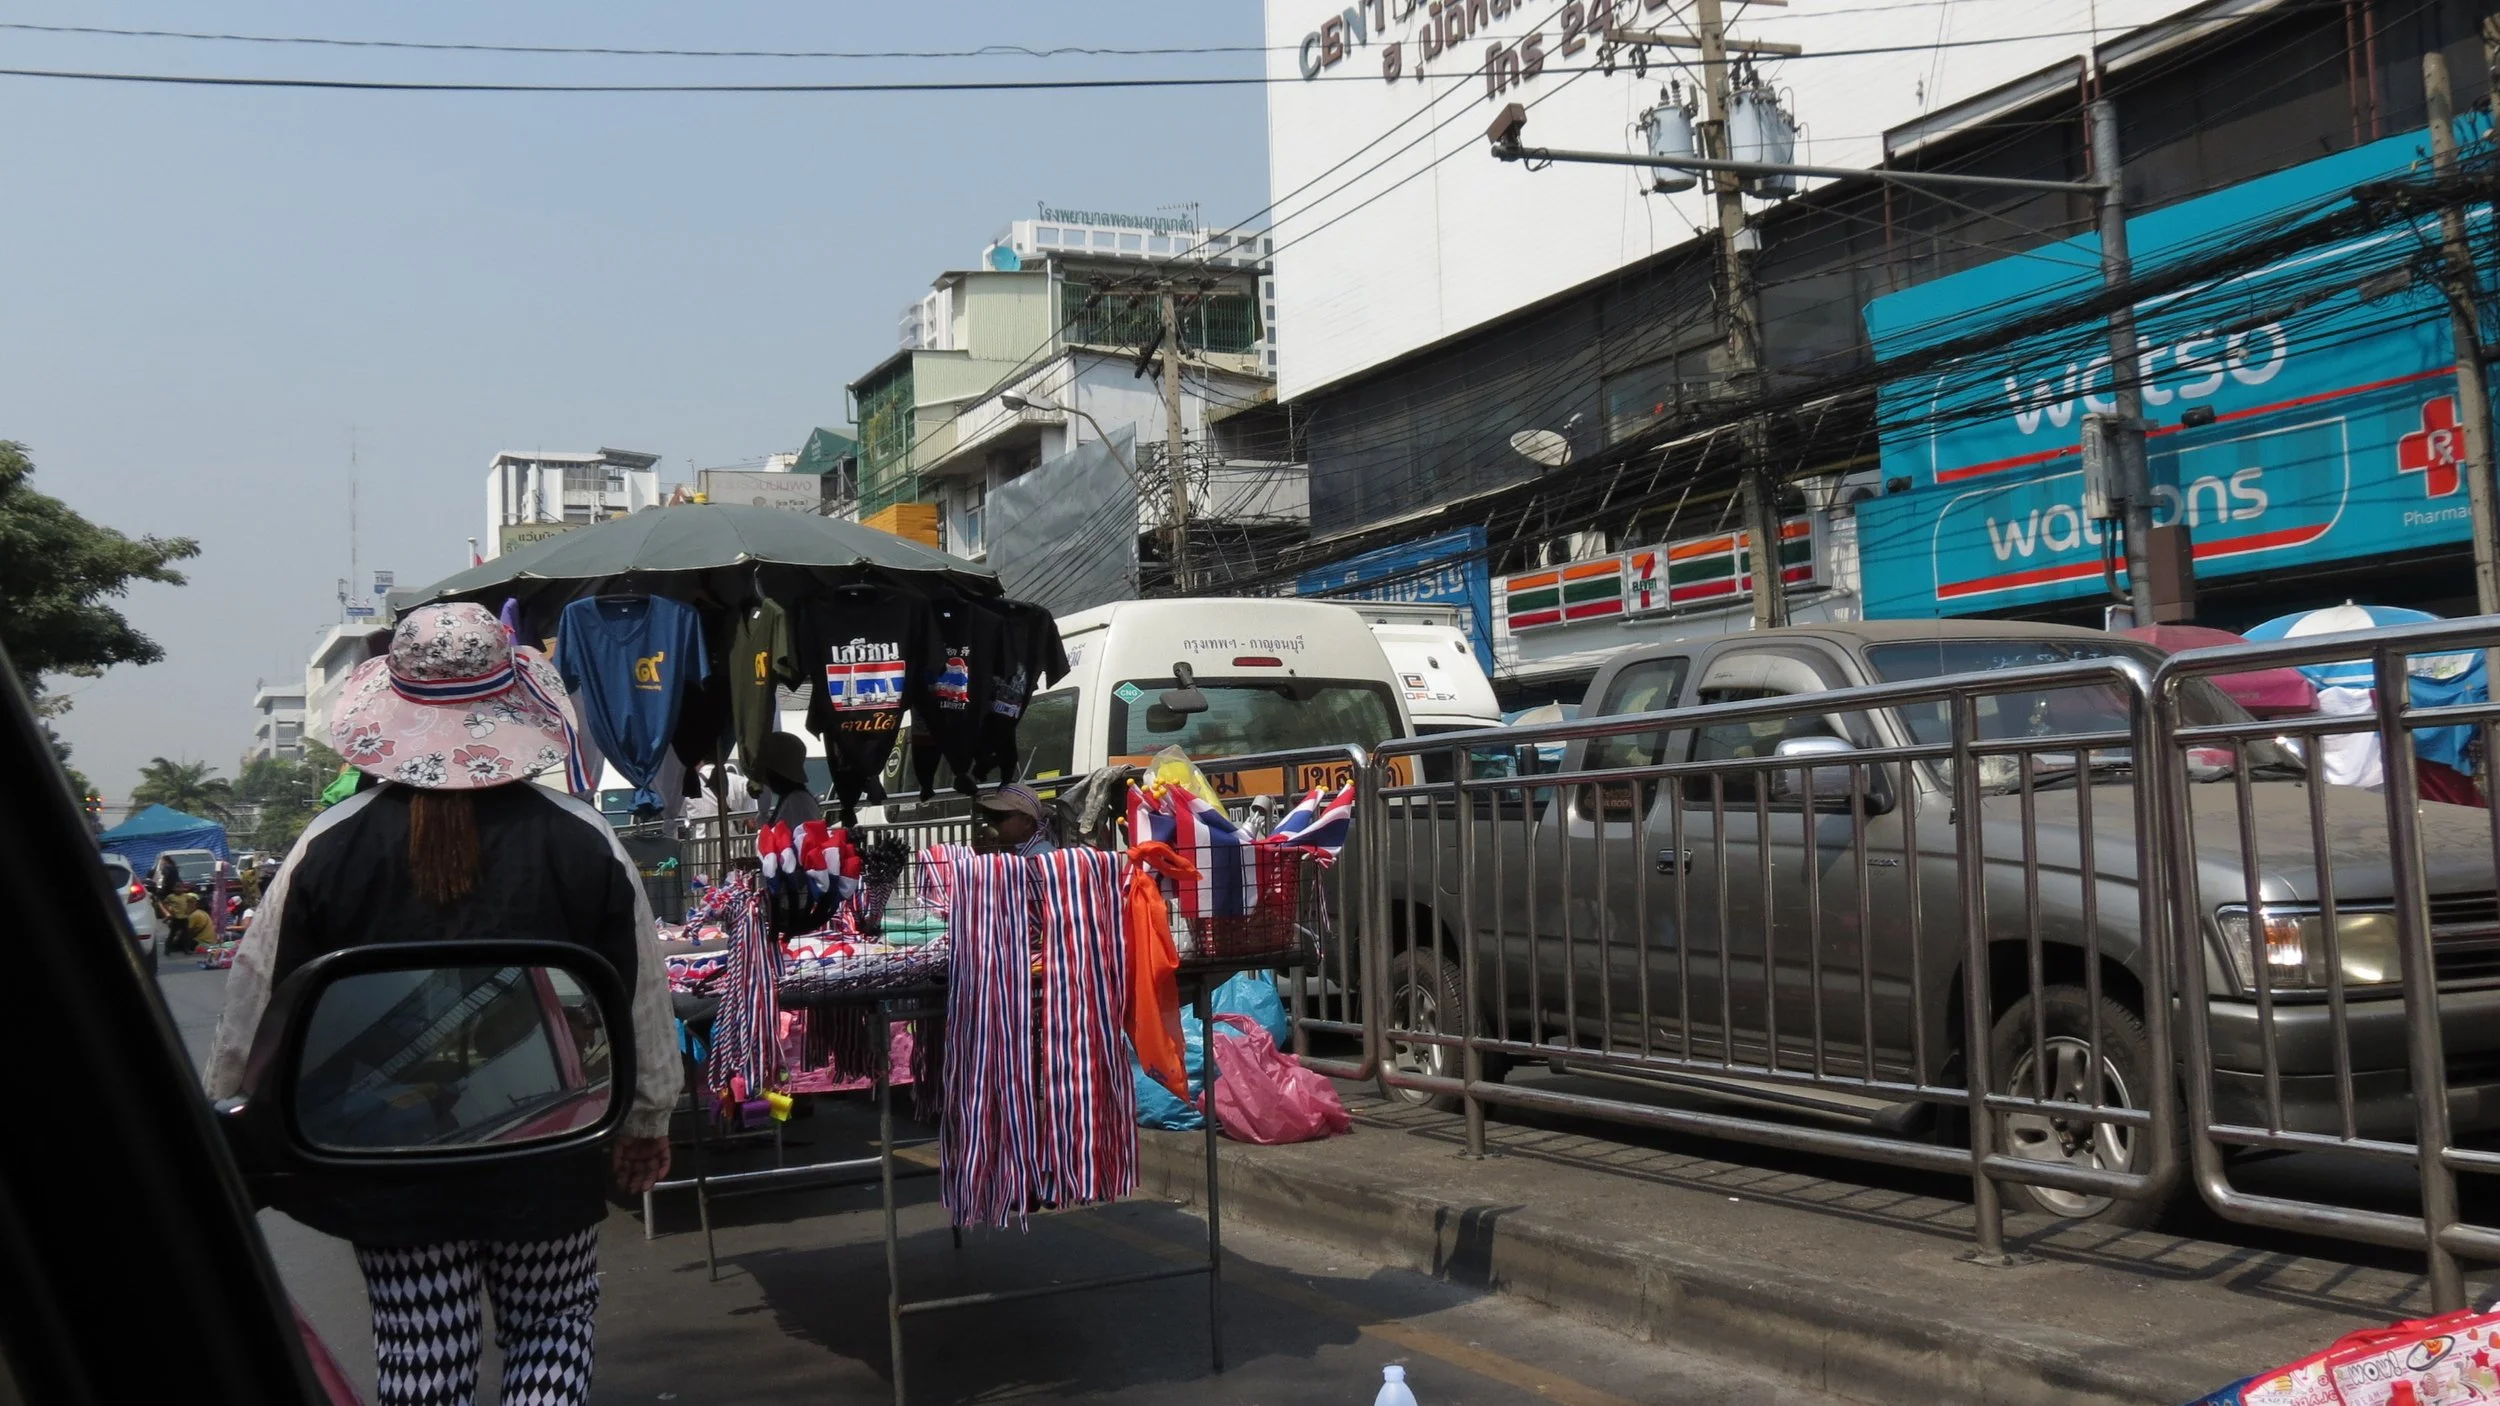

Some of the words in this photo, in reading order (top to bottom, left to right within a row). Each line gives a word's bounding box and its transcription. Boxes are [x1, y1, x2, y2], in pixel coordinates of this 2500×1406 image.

[1985, 467, 2268, 561] watons
[2403, 505, 2474, 526] Pharmac
[1183, 638, 1238, 654] กรุงเทพฯ
[1248, 634, 1305, 654] กาญจนบุรี
[1120, 689, 1138, 697] CNG
[2350, 1350, 2404, 1386] WOW!
